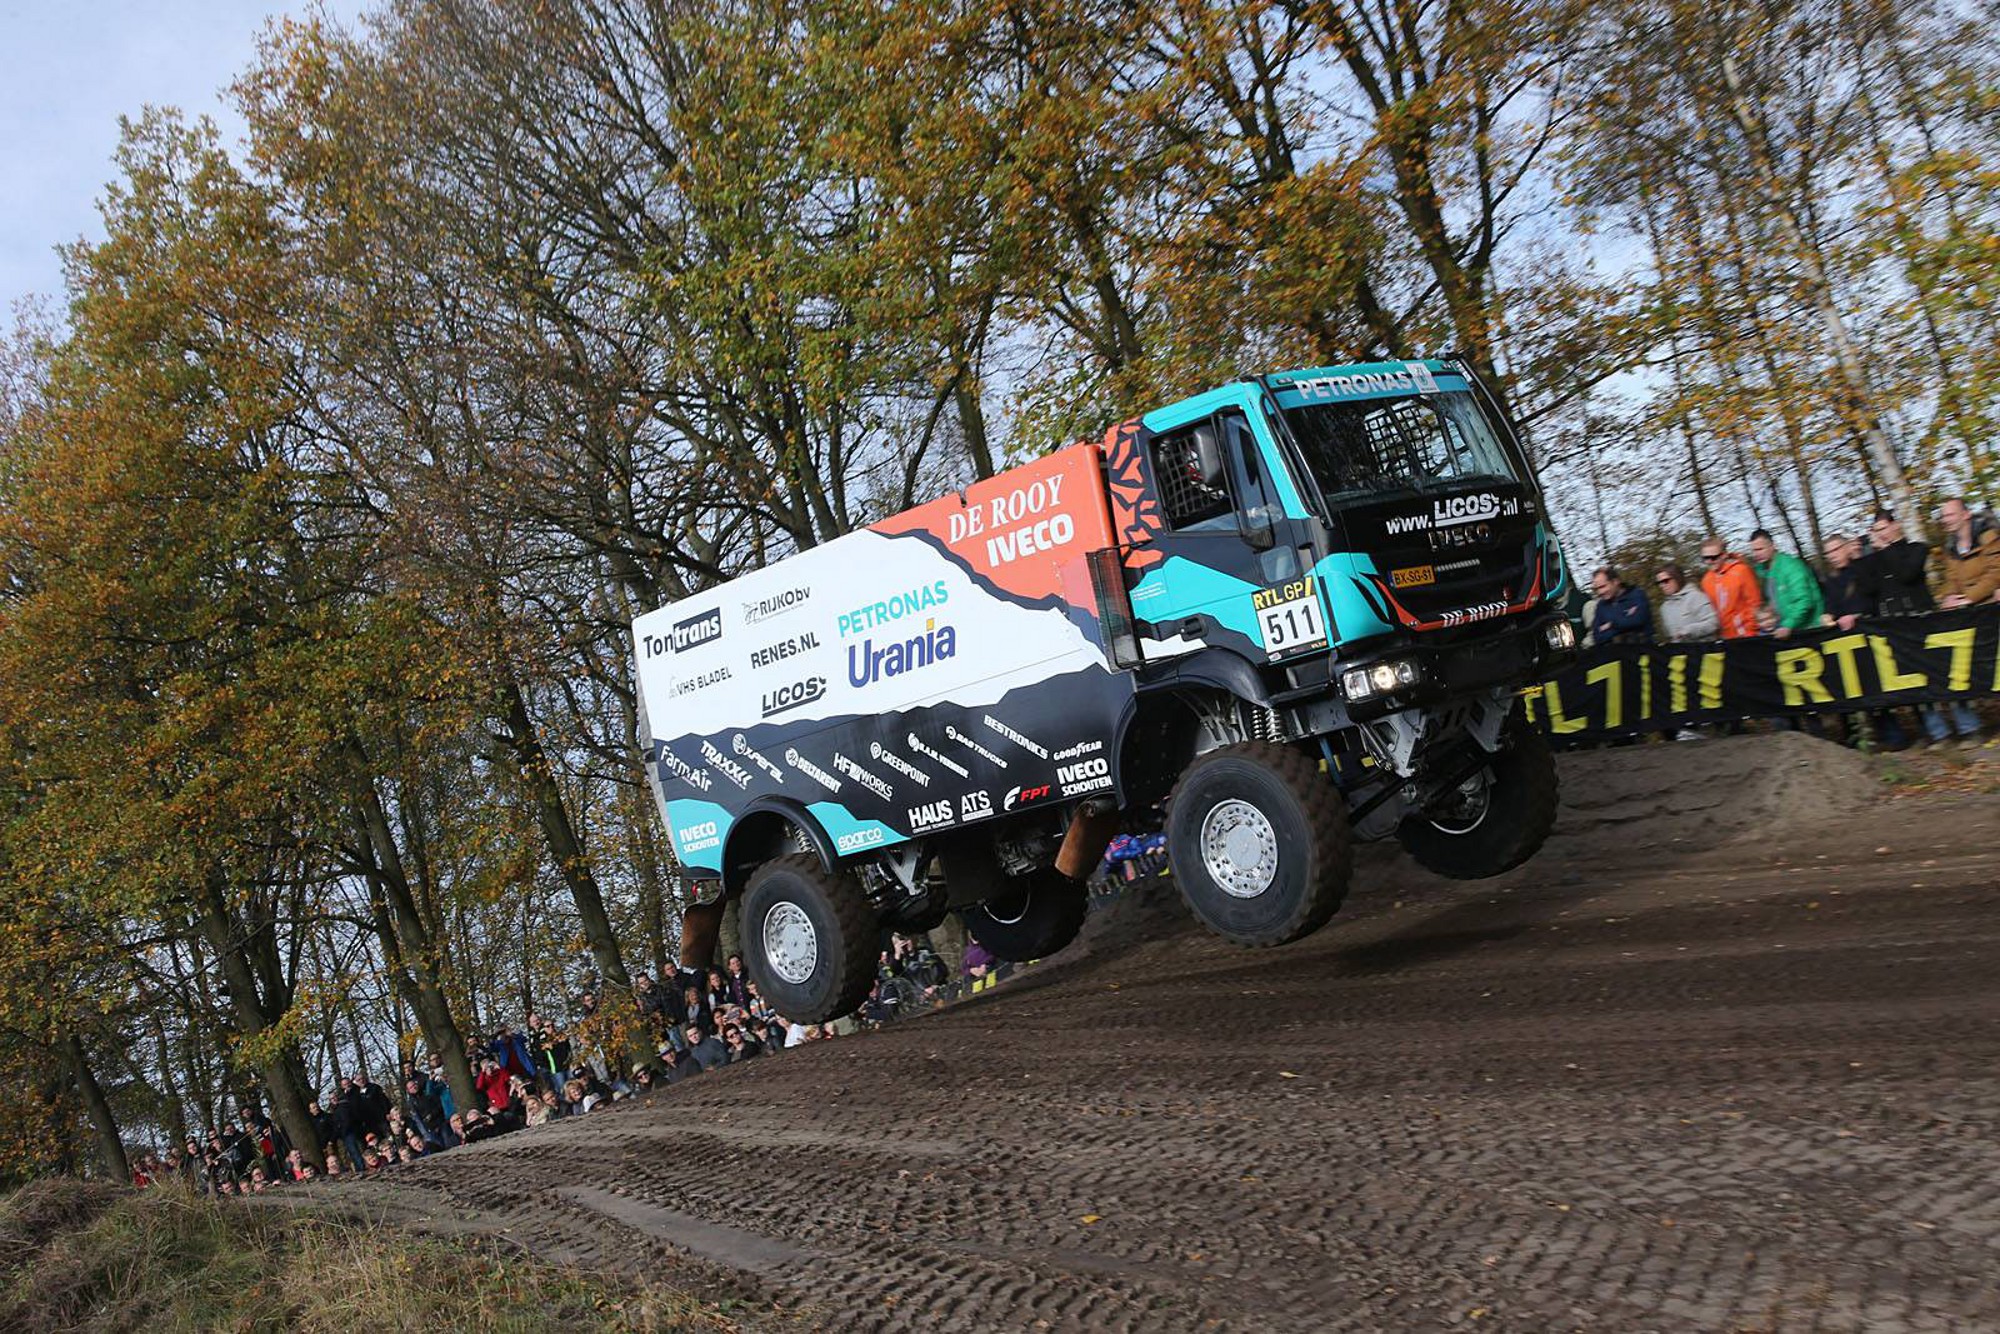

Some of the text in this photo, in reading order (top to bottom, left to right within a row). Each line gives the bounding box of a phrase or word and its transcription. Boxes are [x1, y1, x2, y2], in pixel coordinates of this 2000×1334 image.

[1294, 371, 1412, 400] PETRONAS
[949, 474, 1064, 544] DE ROOY
[986, 514, 1075, 568] IVECO
[838, 581, 949, 637] PETRONAS
[1253, 580, 1303, 610] RTL GP
[1266, 605, 1315, 645] 511
[1466, 601, 1508, 623] ROOY
[643, 614, 720, 659] Tontrans
[751, 632, 820, 669] RENES.NL
[848, 618, 956, 688] Urania
[1775, 627, 1976, 707] RTL7
[677, 666, 733, 696] VHS BLADEL
[762, 677, 819, 712] LICOS
[1521, 660, 1622, 734] TL7
[983, 714, 1049, 760] BESTRONICS
[1053, 740, 1103, 761] GOODYEAR
[881, 750, 931, 787] GREENPOINT
[974, 743, 1008, 769] TRUCKS
[1056, 758, 1109, 785] IVECO
[1061, 775, 1113, 797] SCHOUTEN
[961, 790, 991, 814] ATS
[1020, 784, 1051, 802] FPT
[908, 799, 954, 828] HAUS
[679, 821, 717, 843] IVECO
[838, 827, 882, 849] sparco
